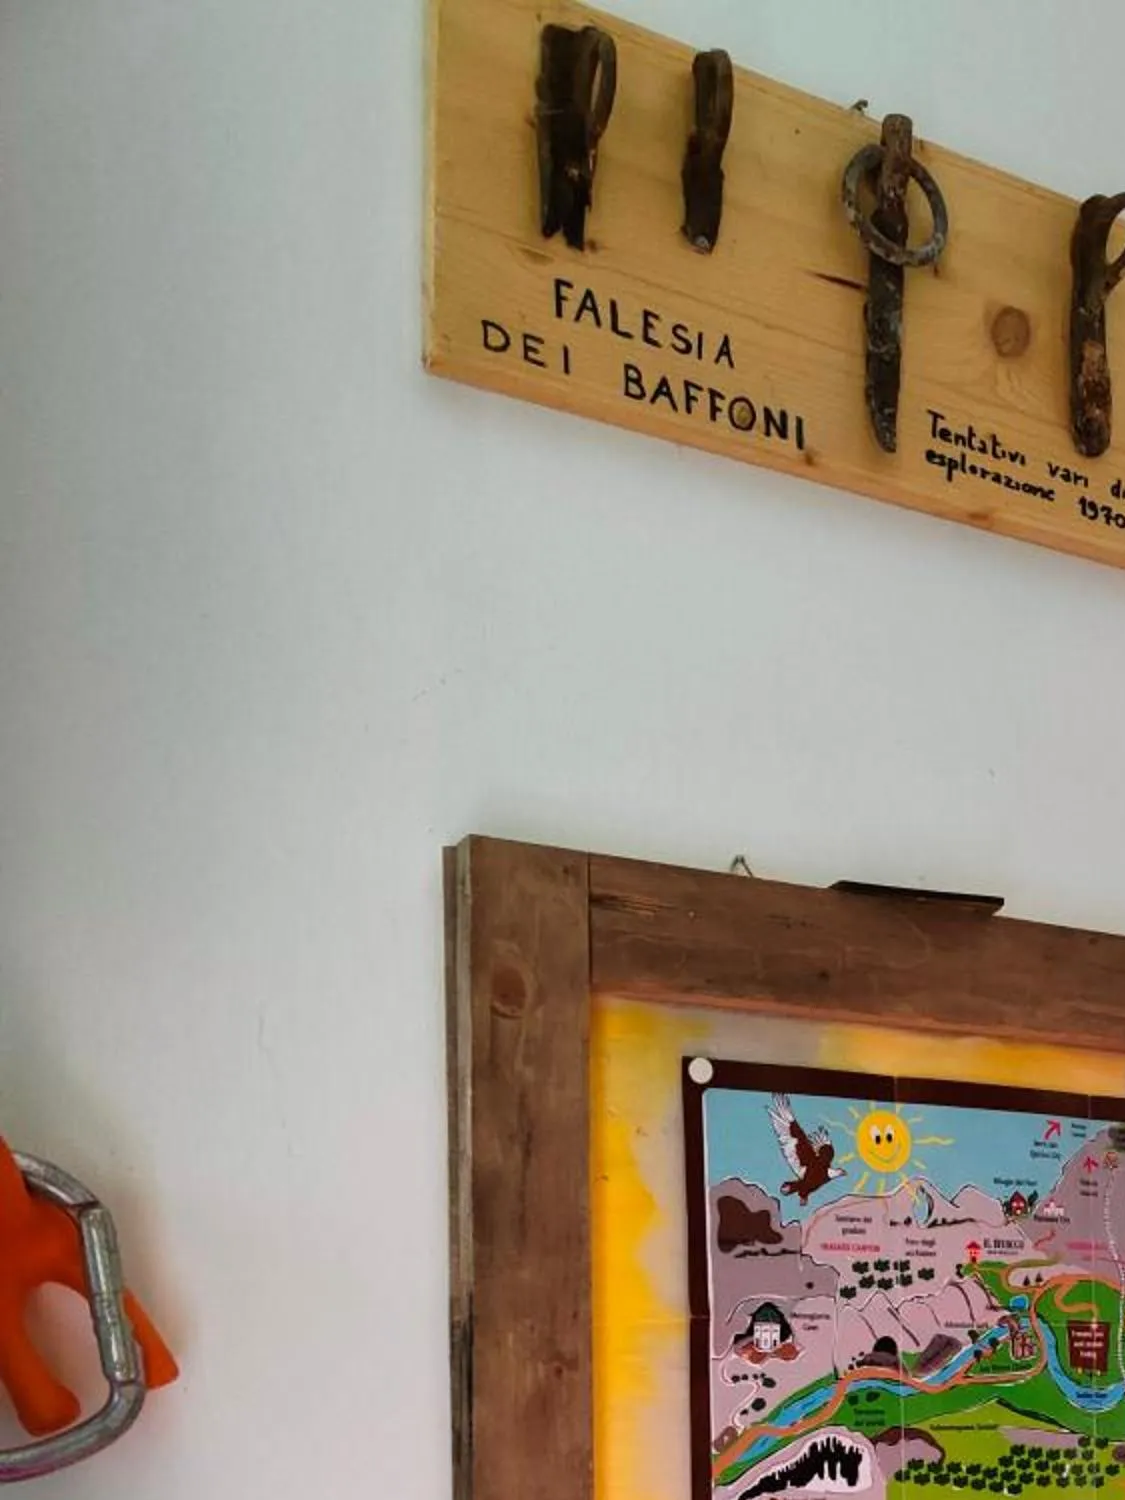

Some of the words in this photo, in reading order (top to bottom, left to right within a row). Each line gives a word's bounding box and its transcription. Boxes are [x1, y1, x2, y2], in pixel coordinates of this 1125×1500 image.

[554, 278, 735, 369] FALESIA
[481, 319, 571, 375] DEI
[623, 362, 805, 451] BAFFONI
[925, 448, 1056, 502] esplorazione
[927, 408, 1027, 467] Tentativi
[1047, 461, 1090, 488] vari
